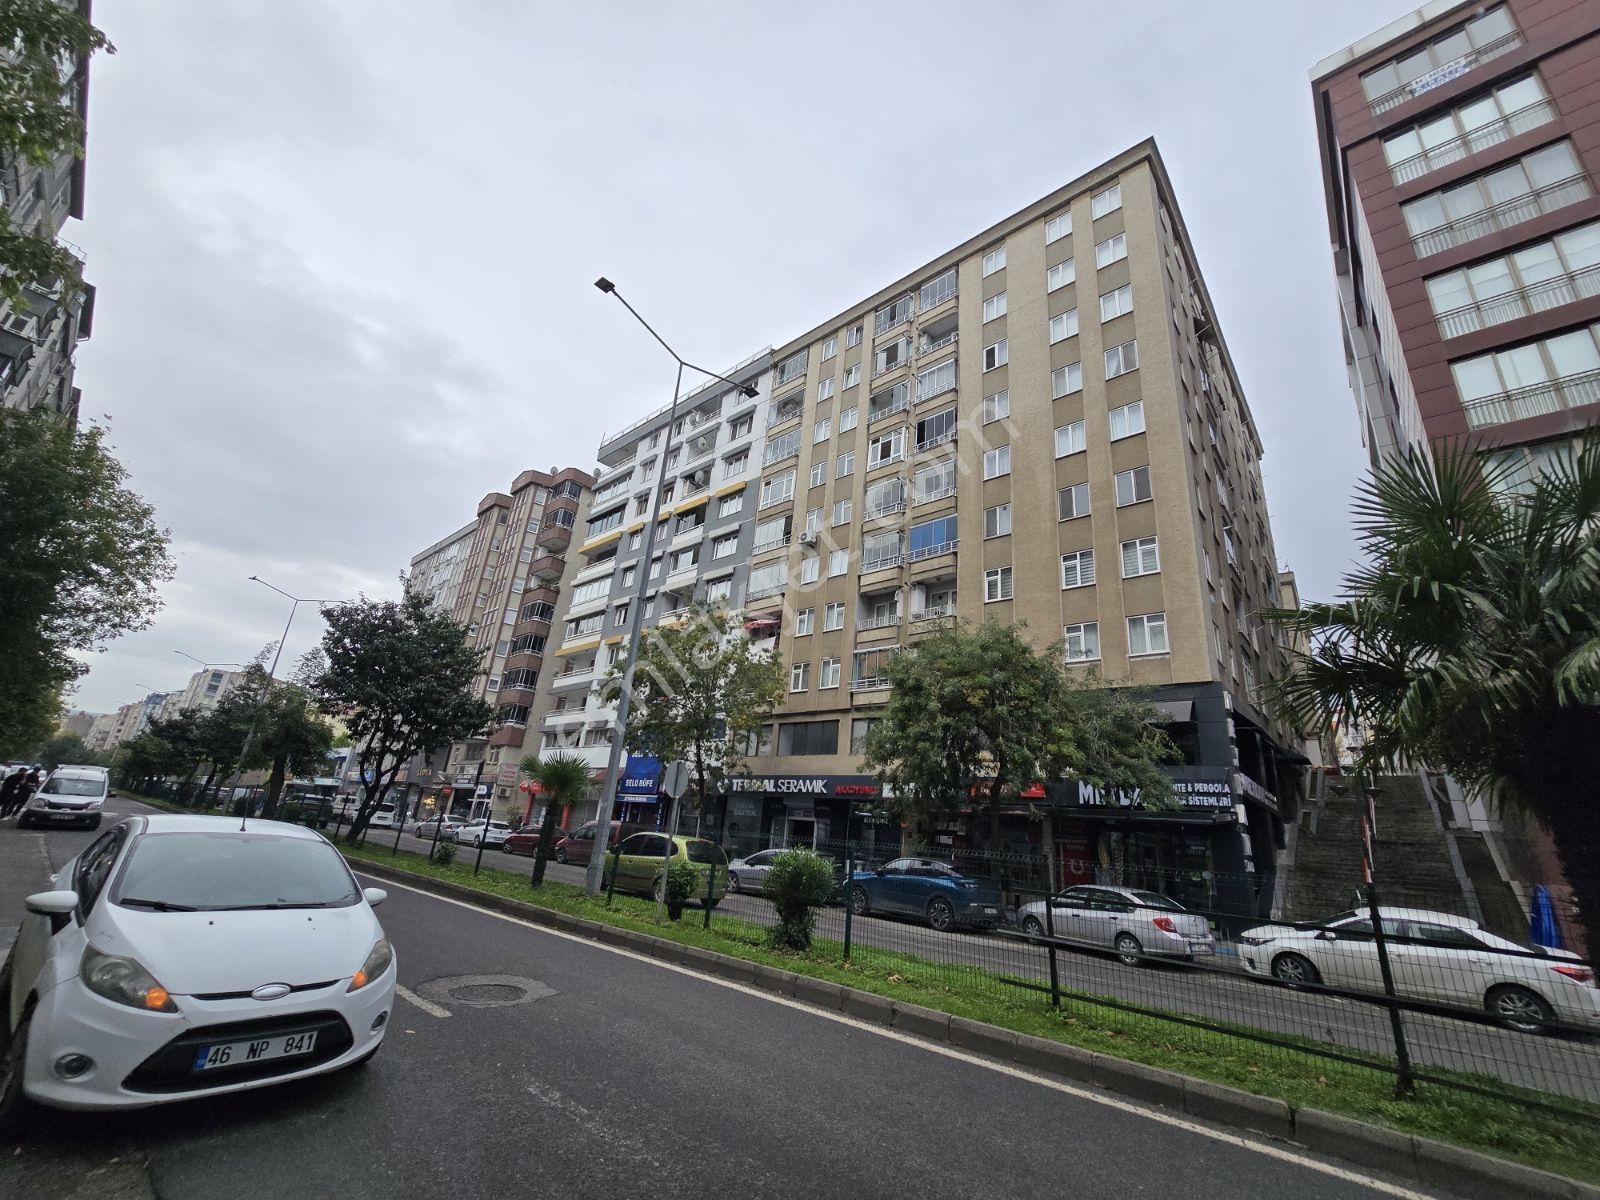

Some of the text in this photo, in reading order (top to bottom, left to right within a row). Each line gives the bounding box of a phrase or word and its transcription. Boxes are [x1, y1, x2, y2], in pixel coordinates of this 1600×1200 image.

[625, 777, 654, 787] SELO BÜFE
[732, 779, 776, 793] TERMAL
[1194, 783, 1231, 794] PERGOLA
[208, 1033, 314, 1065] 46 NP 841
